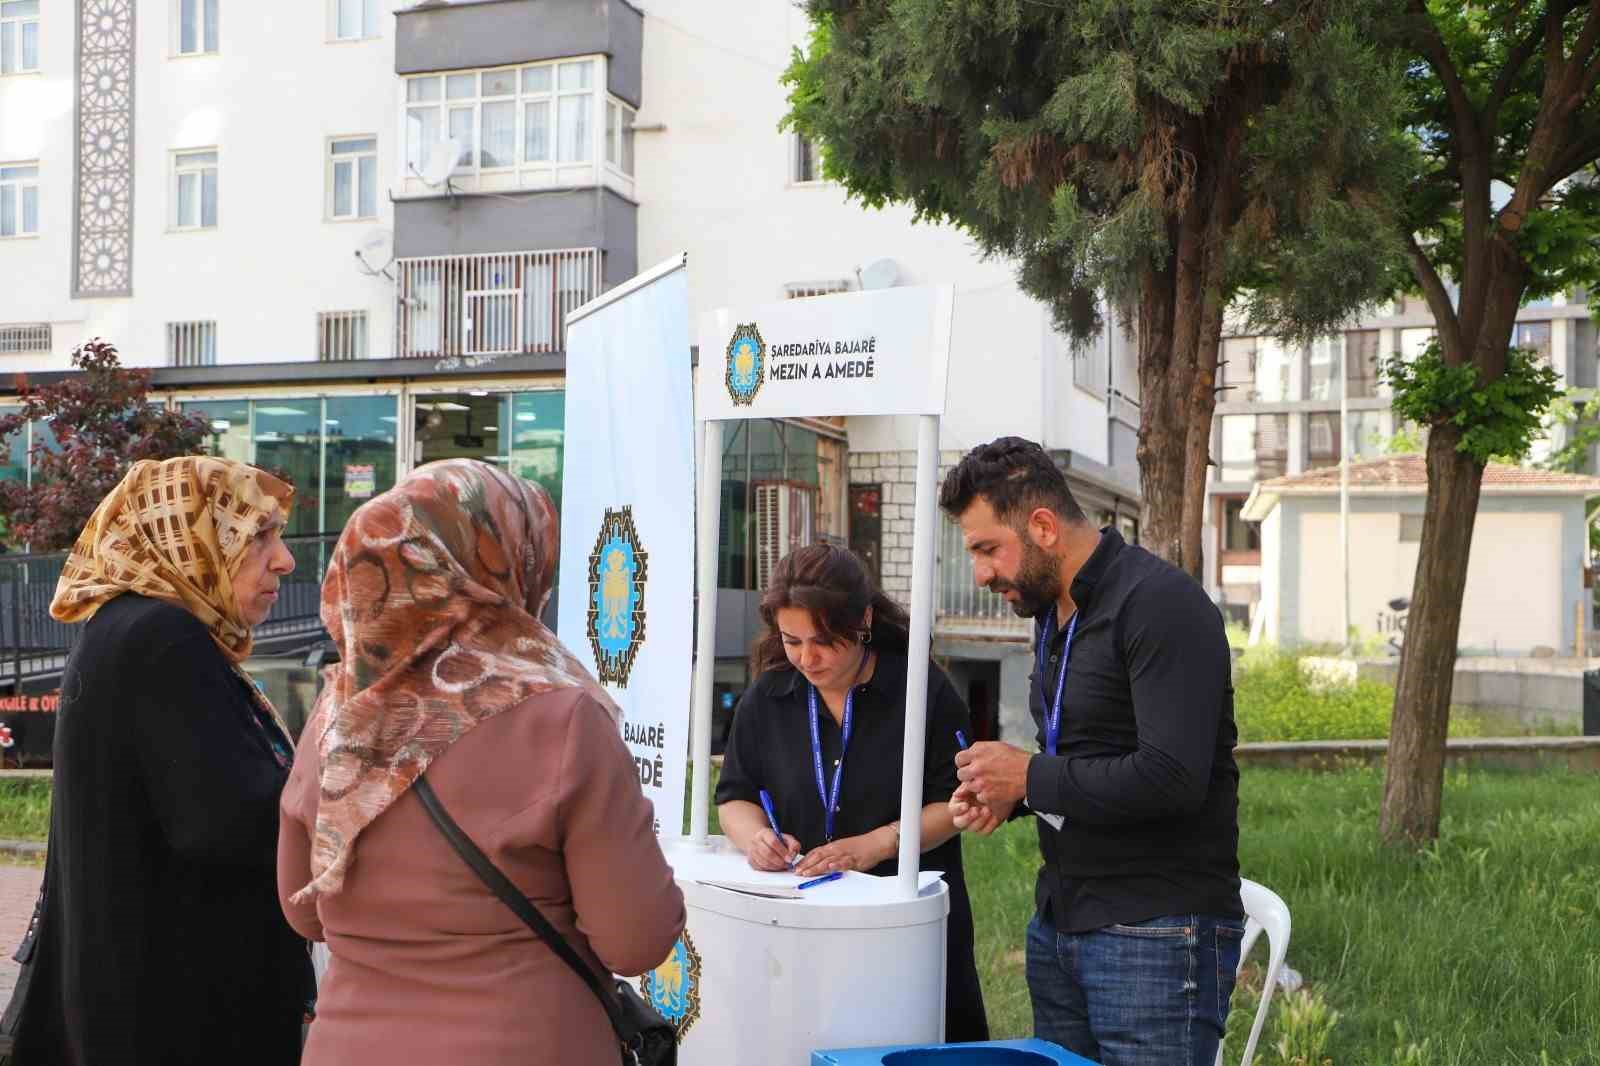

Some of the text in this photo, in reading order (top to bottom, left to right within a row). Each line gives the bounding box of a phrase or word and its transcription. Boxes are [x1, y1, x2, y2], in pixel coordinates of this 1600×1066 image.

[835, 336, 876, 354] BAJARÊ
[769, 356, 875, 380] MEZIN A AMEDÊ
[624, 722, 665, 748] BAJARÊ
